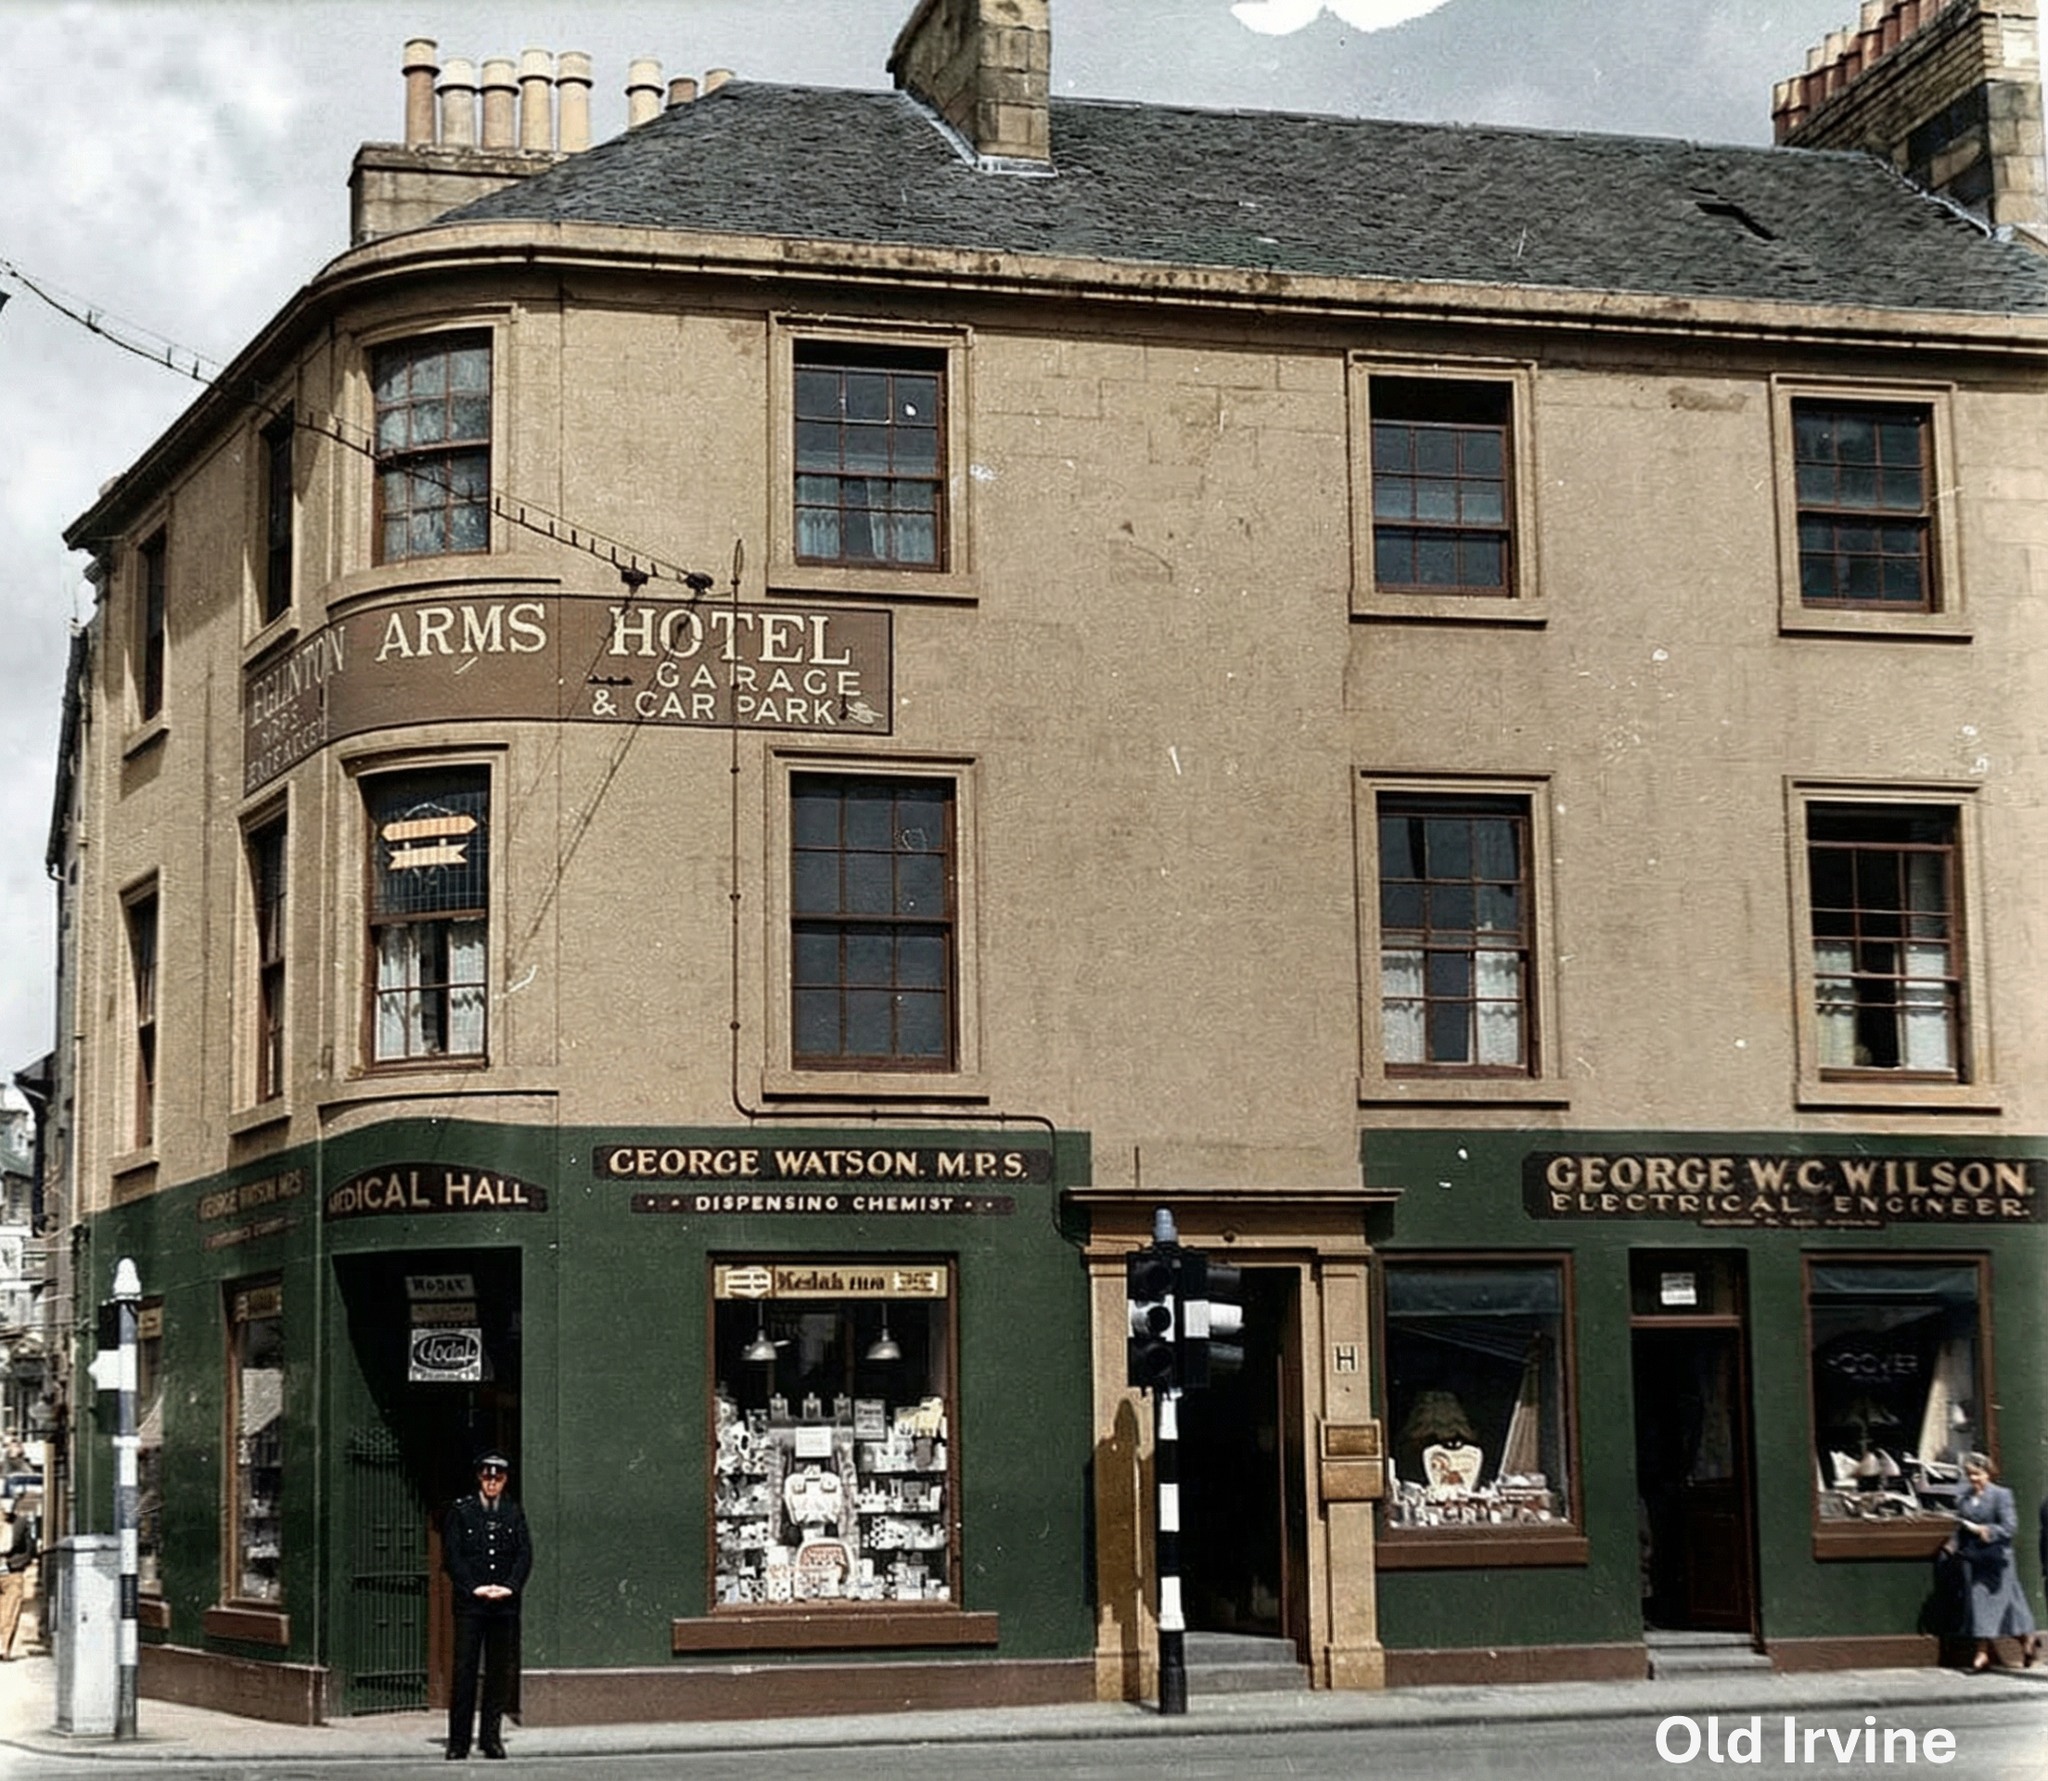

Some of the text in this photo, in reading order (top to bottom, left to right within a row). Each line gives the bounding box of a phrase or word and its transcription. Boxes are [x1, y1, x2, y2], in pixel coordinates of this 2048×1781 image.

[375, 603, 547, 662] ARMS
[608, 606, 850, 665] HOTEL
[656, 661, 862, 696] GARAGE
[591, 689, 837, 726] & CAR PARK
[608, 1148, 761, 1176] GEORGE
[1546, 1156, 1735, 1193] GEORGE
[328, 1171, 529, 1213] MEDICAL HALL
[695, 1194, 954, 1212] DISPENSING CHEMIST
[1551, 1193, 1803, 1213] ELECTRICAL
[1336, 1345, 1355, 1371] H
